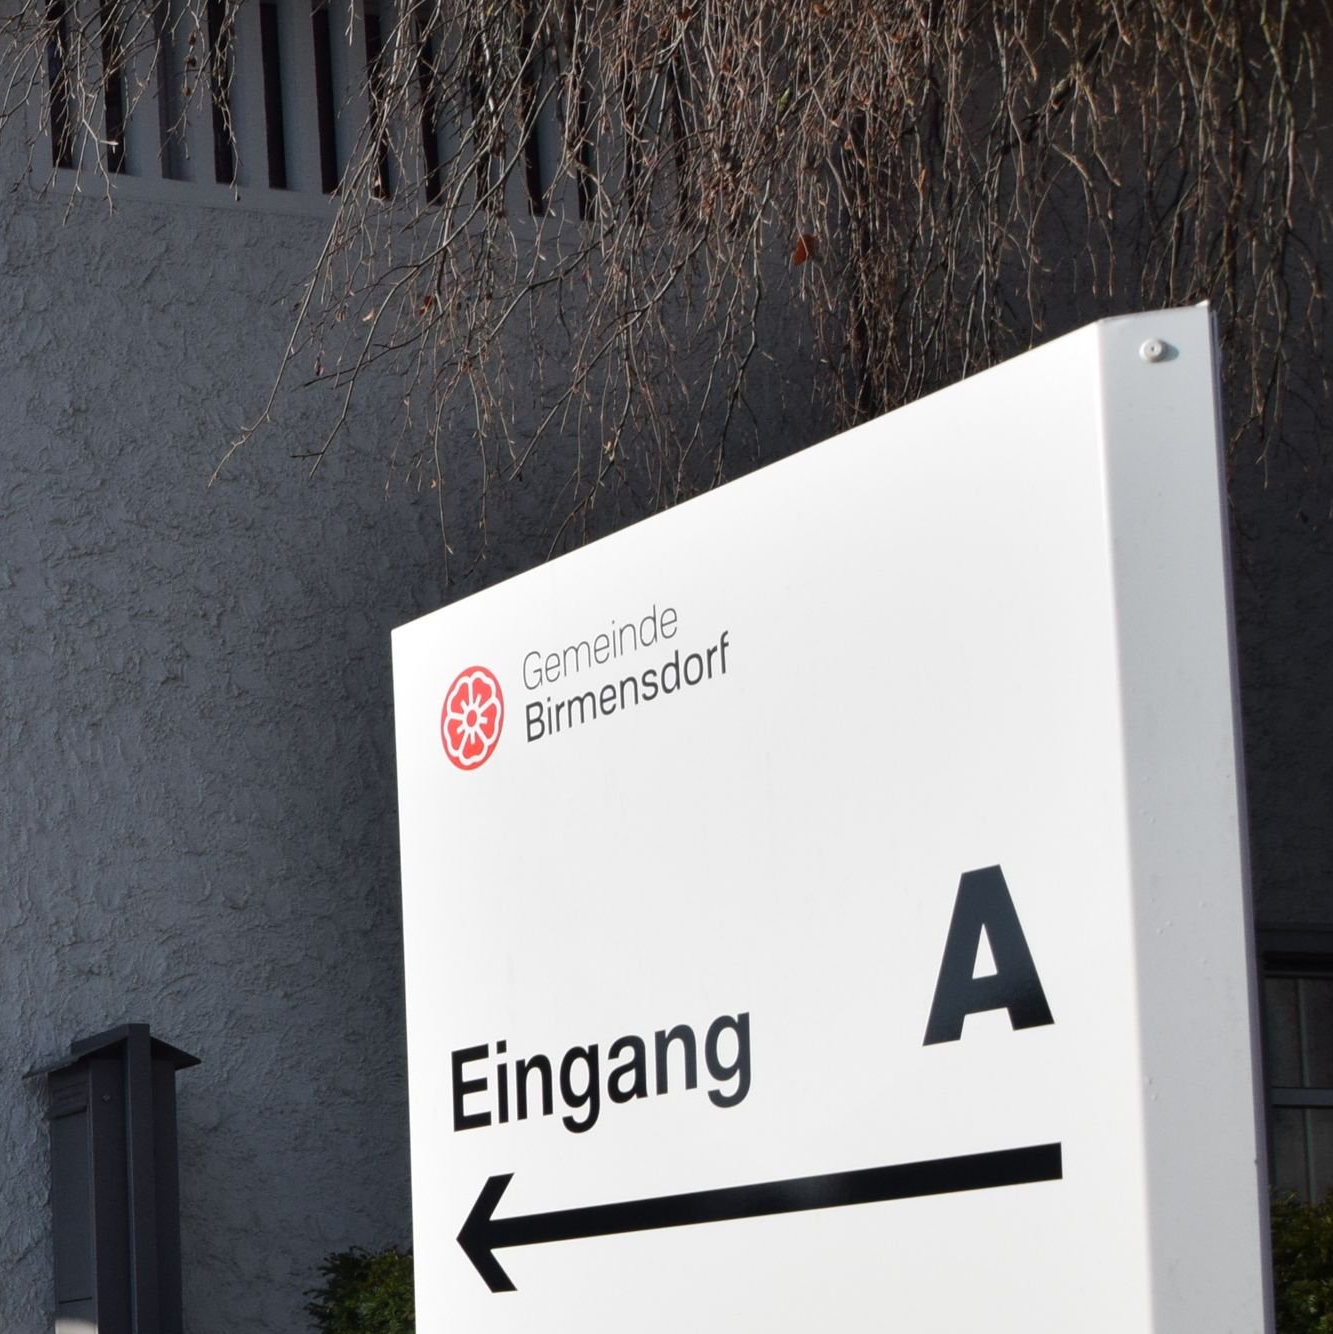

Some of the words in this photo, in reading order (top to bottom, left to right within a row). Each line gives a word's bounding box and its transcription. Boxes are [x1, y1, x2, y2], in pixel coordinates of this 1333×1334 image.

[522, 604, 679, 692] Gemeinde
[524, 631, 731, 743] Birmensdorf
[923, 864, 1054, 1047] A
[452, 1013, 752, 1133] Eingang
